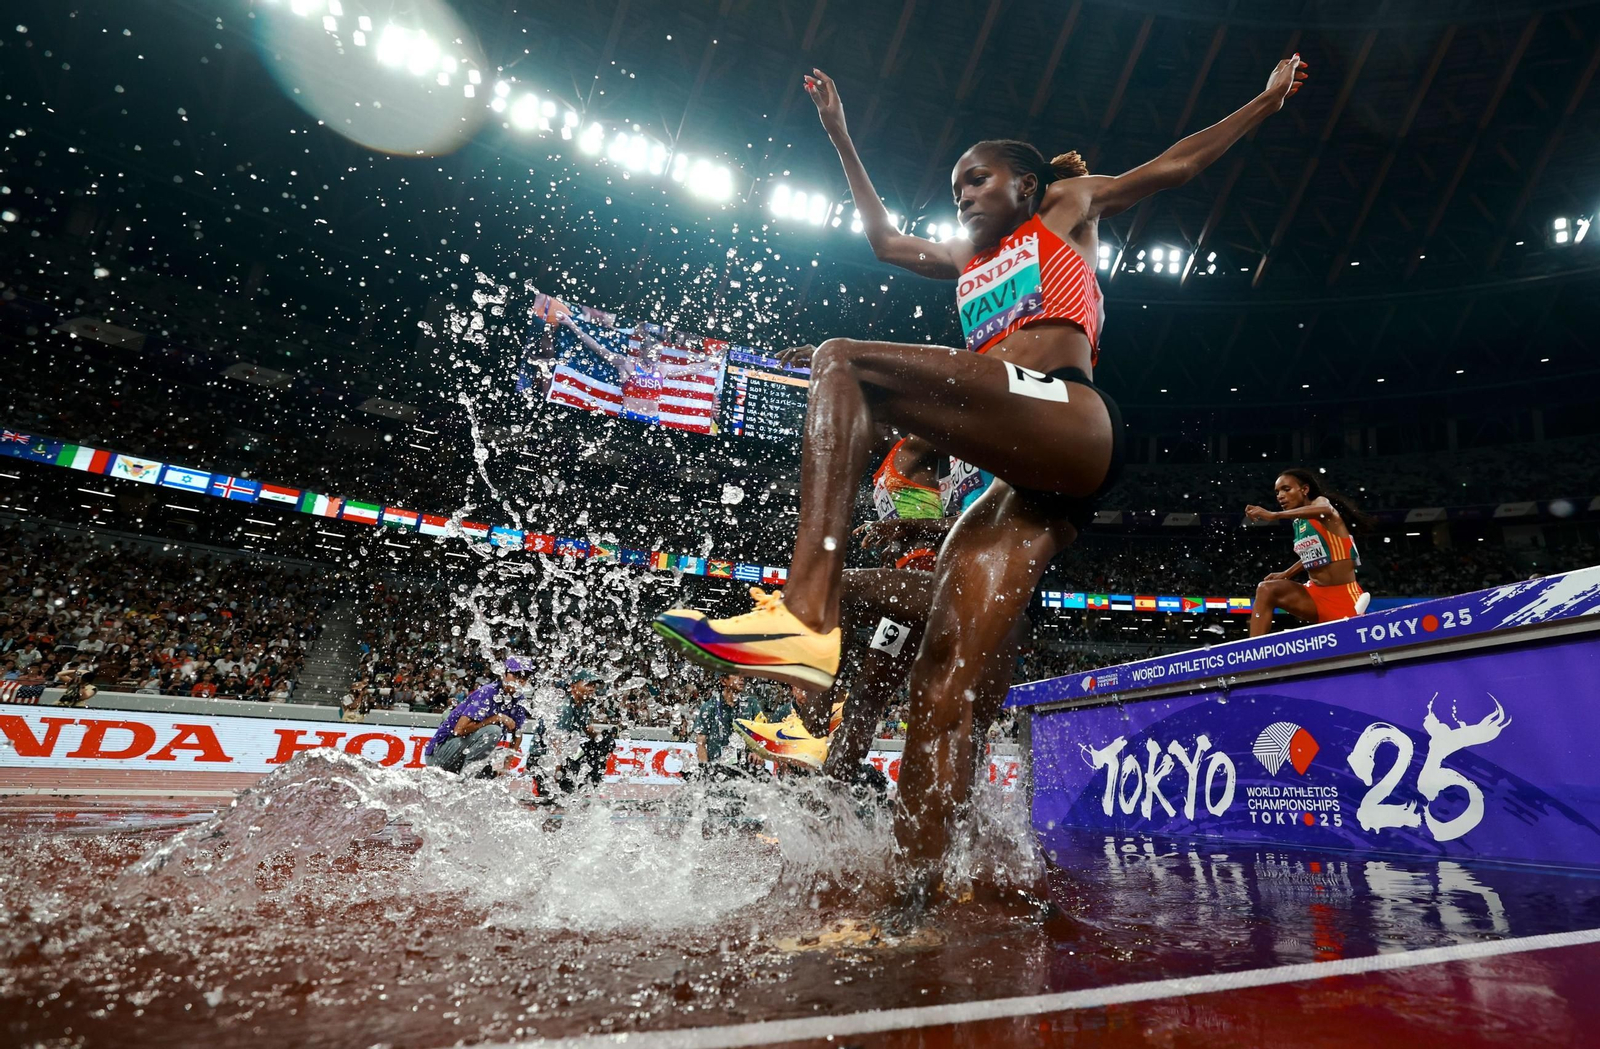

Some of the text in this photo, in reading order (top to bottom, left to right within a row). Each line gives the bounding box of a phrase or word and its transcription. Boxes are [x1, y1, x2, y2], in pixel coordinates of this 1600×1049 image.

[957, 249, 1035, 299] ONDA
[962, 278, 1018, 328] YAVI
[639, 378, 662, 390] USA
[1441, 608, 1473, 629] 25
[879, 624, 900, 647] 9
[1131, 664, 1166, 682] WORLD
[1168, 654, 1225, 676] ATHLETICS
[1227, 632, 1338, 666] CHAMPIONSHIPS
[1078, 692, 1512, 841] TOKYO 25
[1246, 786, 1339, 798] WORLD ATHLETICS
[1247, 798, 1341, 812] CHAMPIONSHIPS
[1319, 813, 1343, 827] 25
